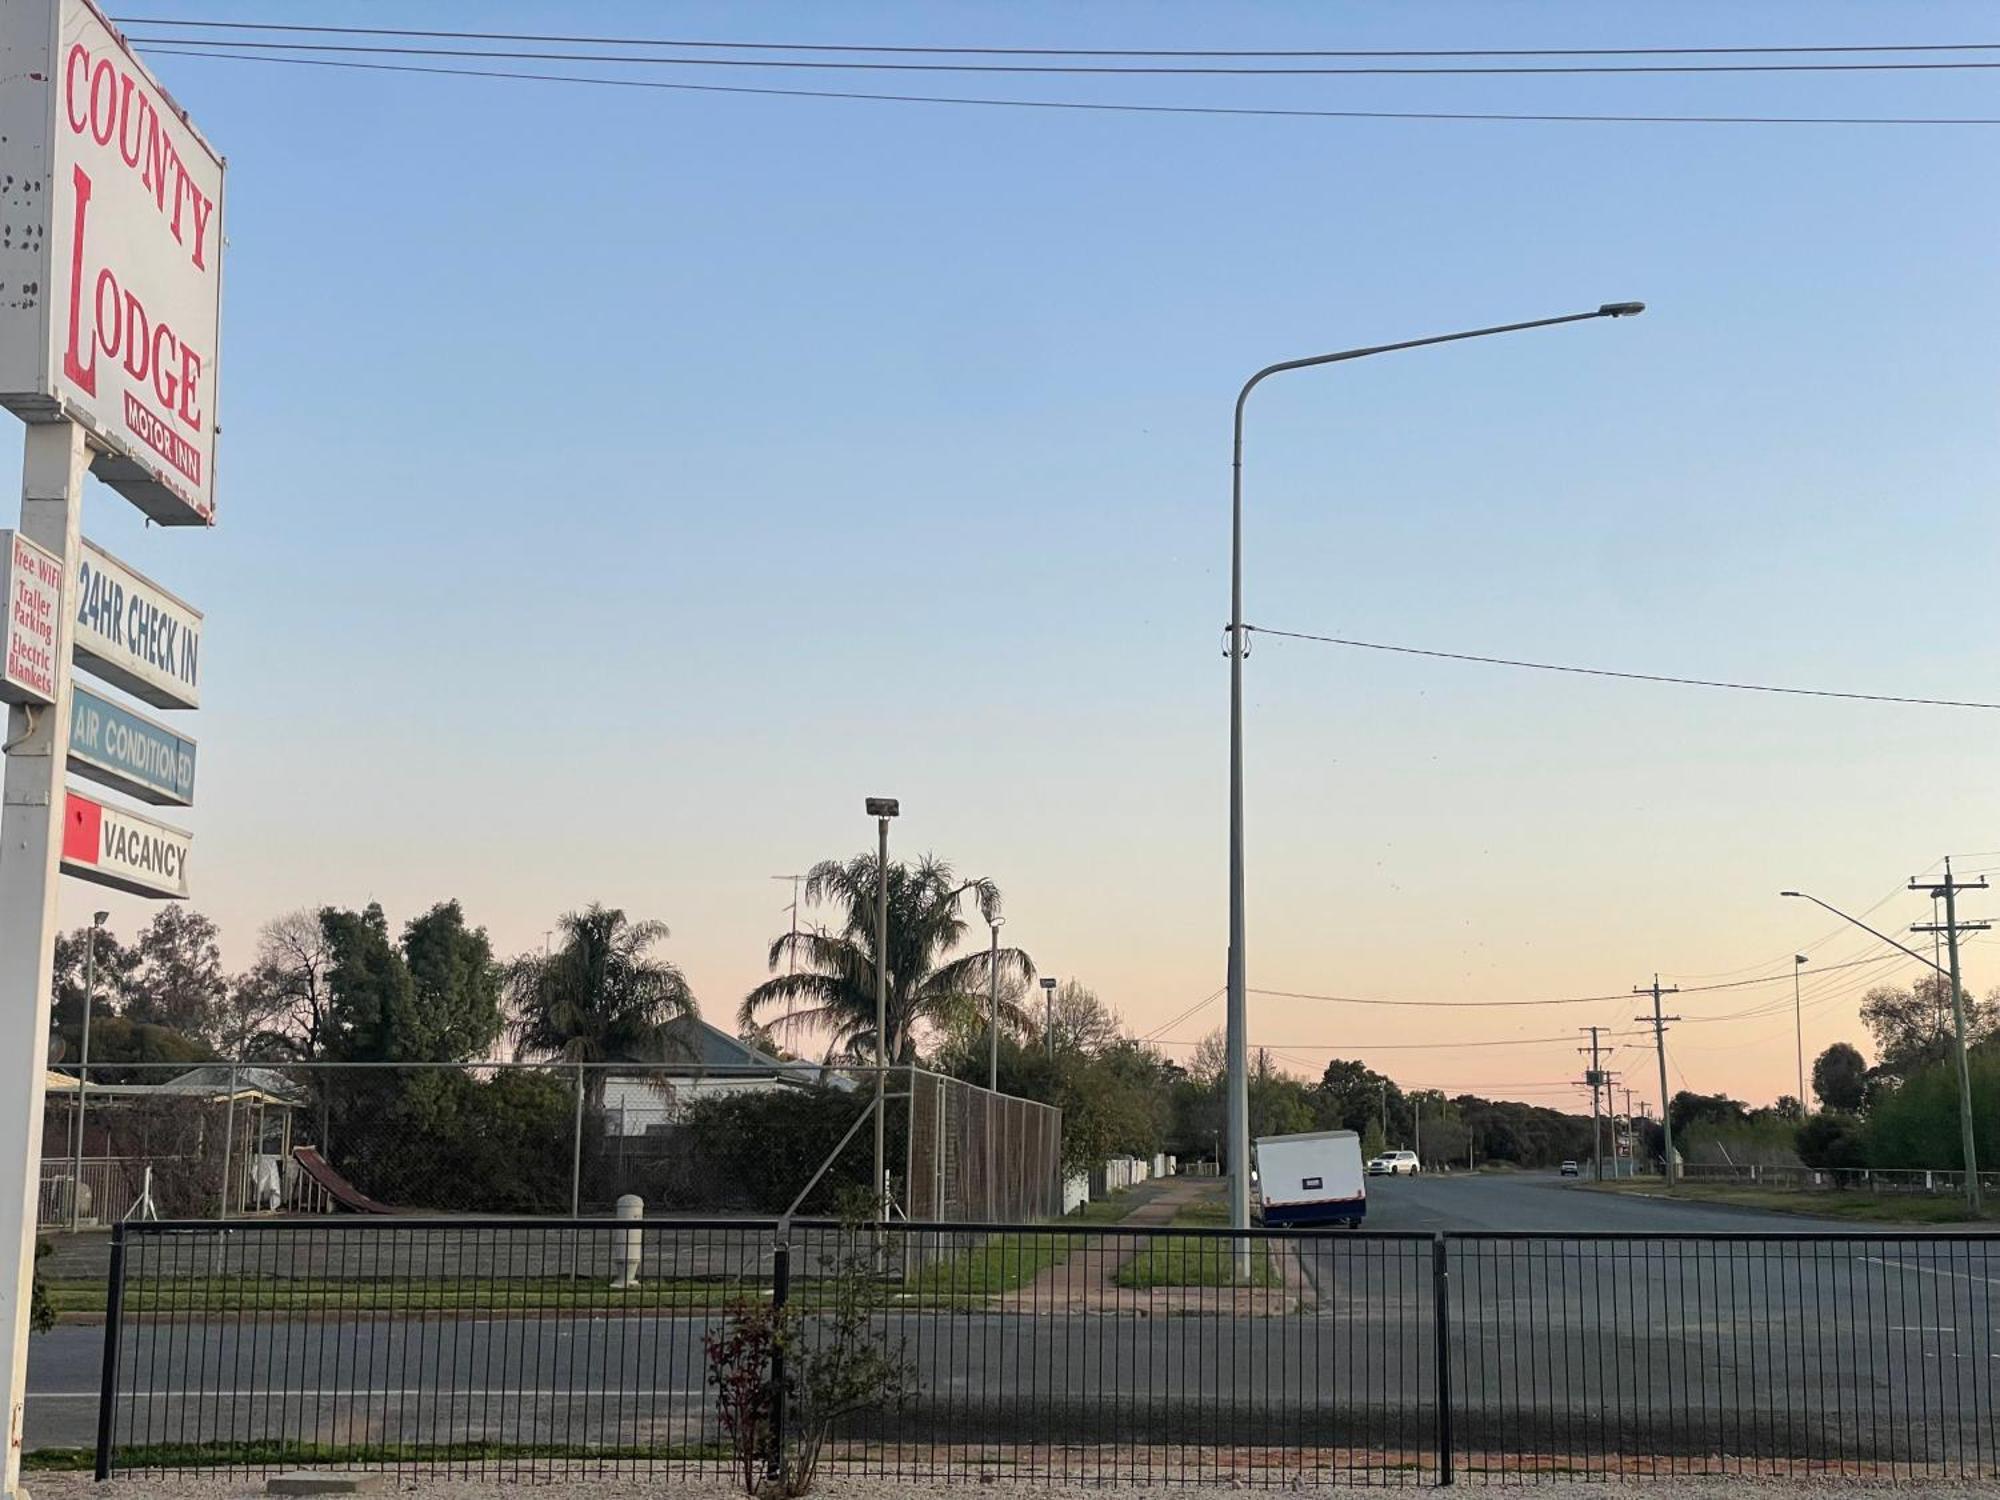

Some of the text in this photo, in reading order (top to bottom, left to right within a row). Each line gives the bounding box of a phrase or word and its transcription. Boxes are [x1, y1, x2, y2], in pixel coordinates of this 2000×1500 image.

[67, 44, 212, 271] COUNTY
[64, 163, 200, 432] LODGE
[128, 397, 198, 480] MOTOR INN
[14, 600, 52, 645] Parking
[20, 579, 51, 617] Trailer
[77, 561, 198, 687] 24HR CHECK IN
[8, 652, 52, 693] Blankets
[13, 632, 50, 671] Electric
[74, 705, 99, 749] AIR
[104, 820, 188, 881] VACANCY
